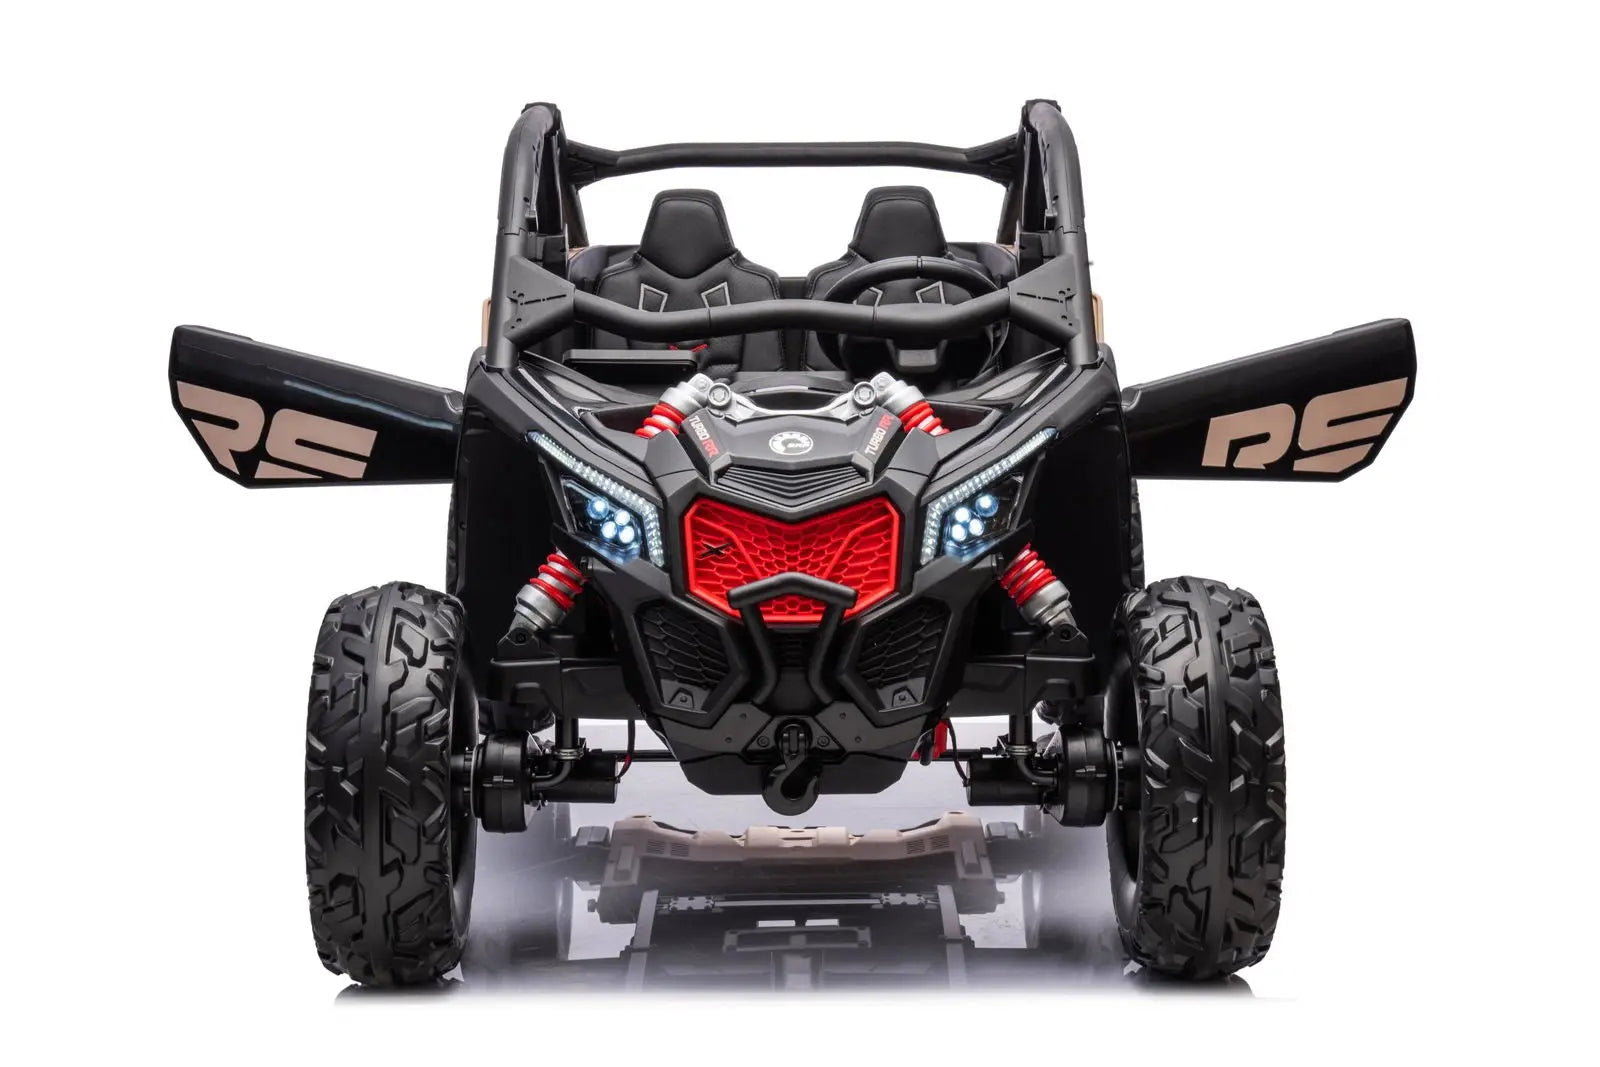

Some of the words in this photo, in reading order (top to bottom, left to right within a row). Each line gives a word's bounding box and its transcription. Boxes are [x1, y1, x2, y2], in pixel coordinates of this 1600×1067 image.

[176, 380, 378, 479] RS
[689, 415, 710, 440] TURBO
[864, 427, 887, 455] TURBO
[1201, 377, 1408, 473] RS
